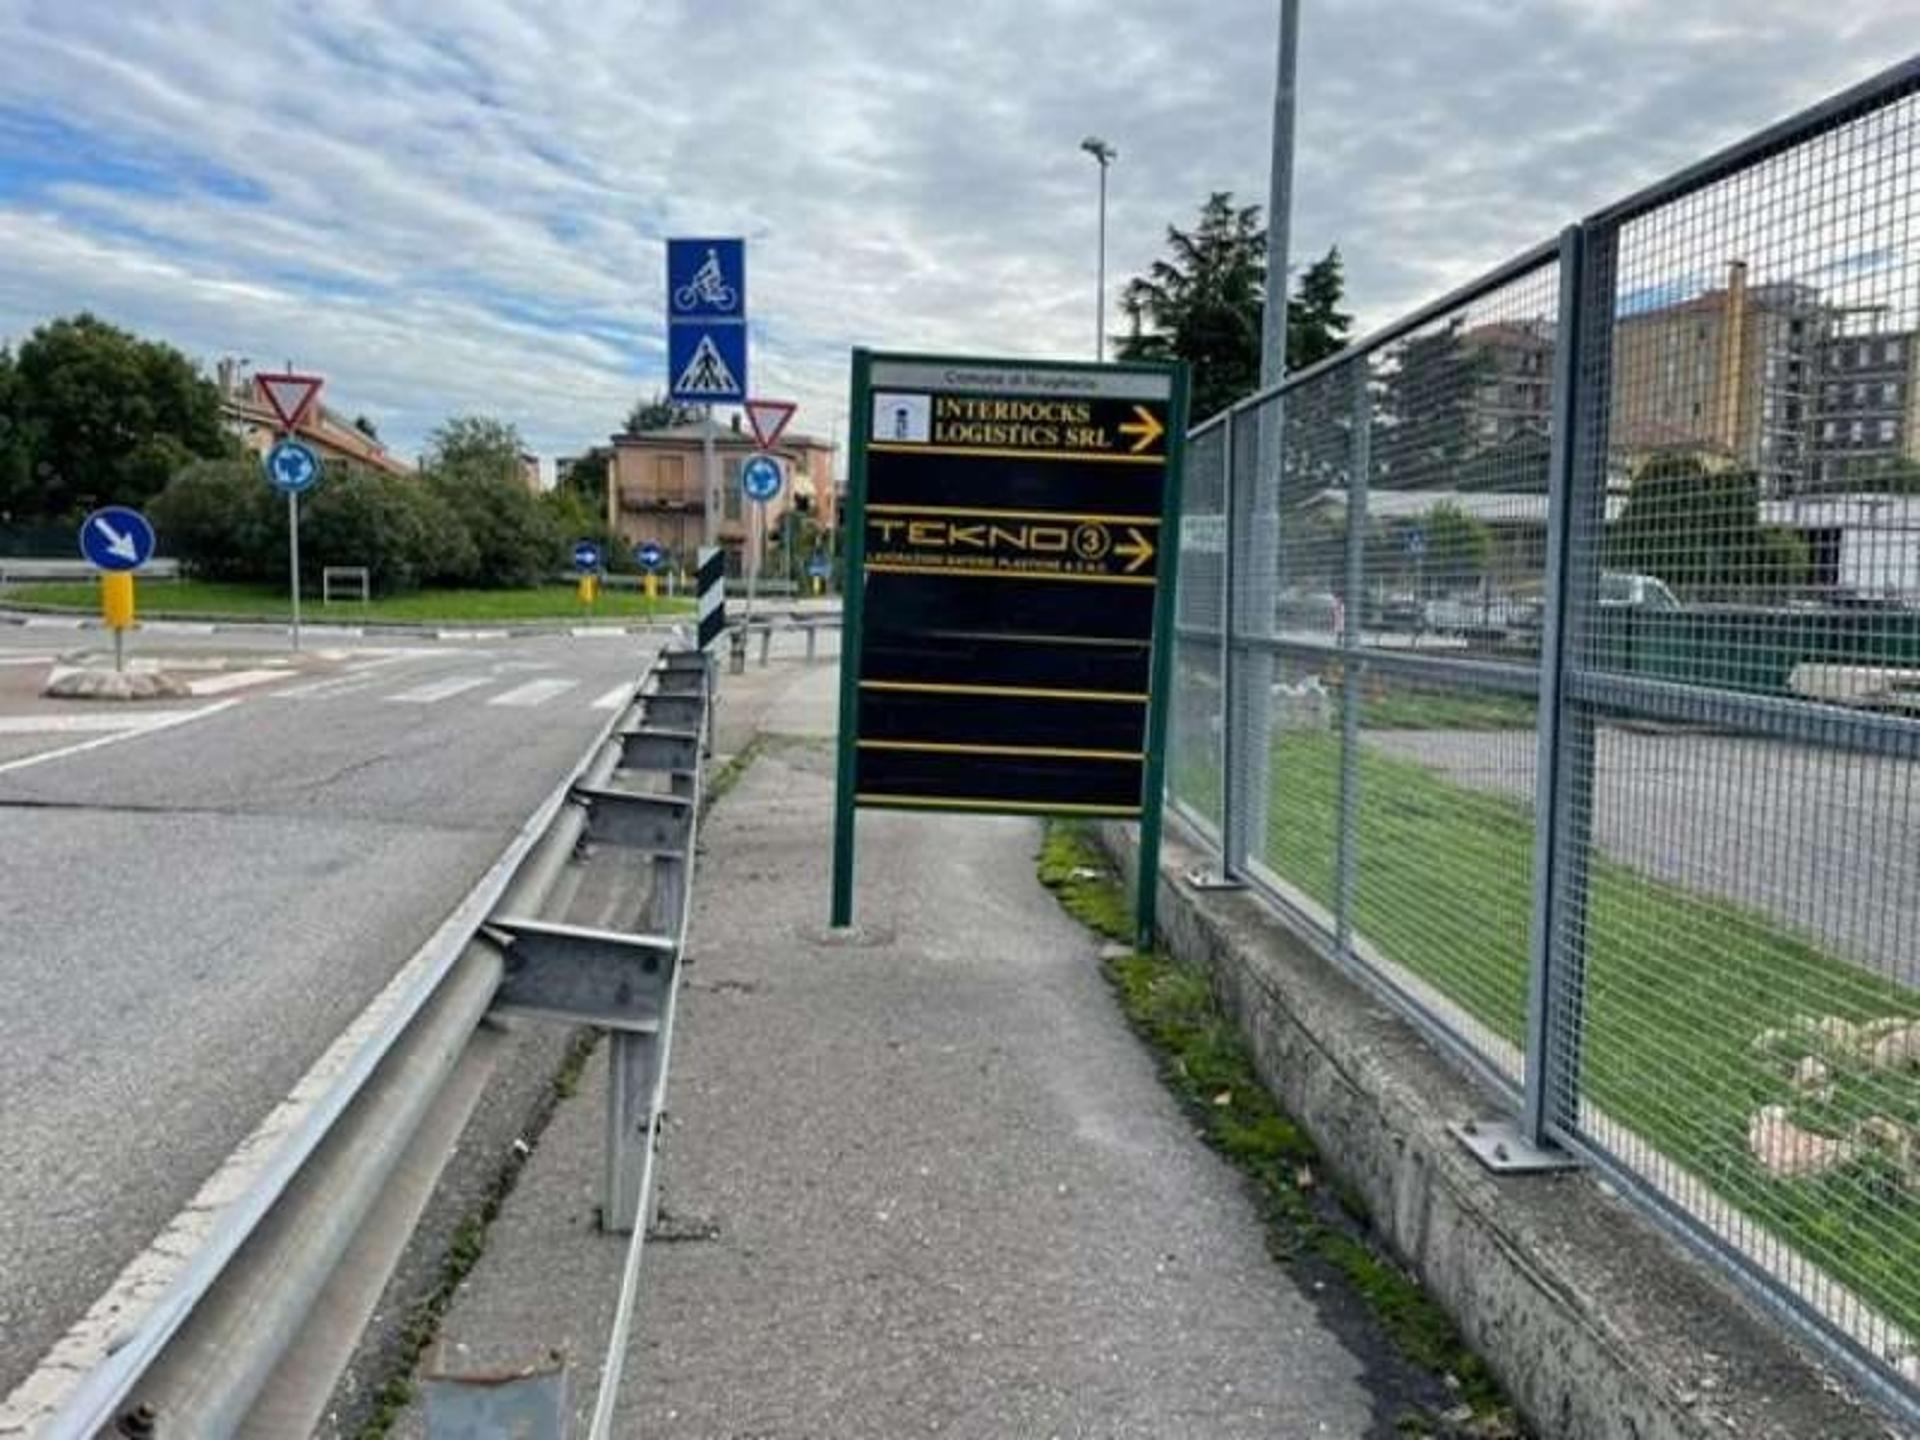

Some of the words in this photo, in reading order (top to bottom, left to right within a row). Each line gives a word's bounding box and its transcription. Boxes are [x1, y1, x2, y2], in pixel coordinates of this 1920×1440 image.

[935, 398, 1091, 423] INTERDOCKS
[935, 422, 1057, 446] LOGISTICS
[868, 519, 1068, 550] TEKNO
